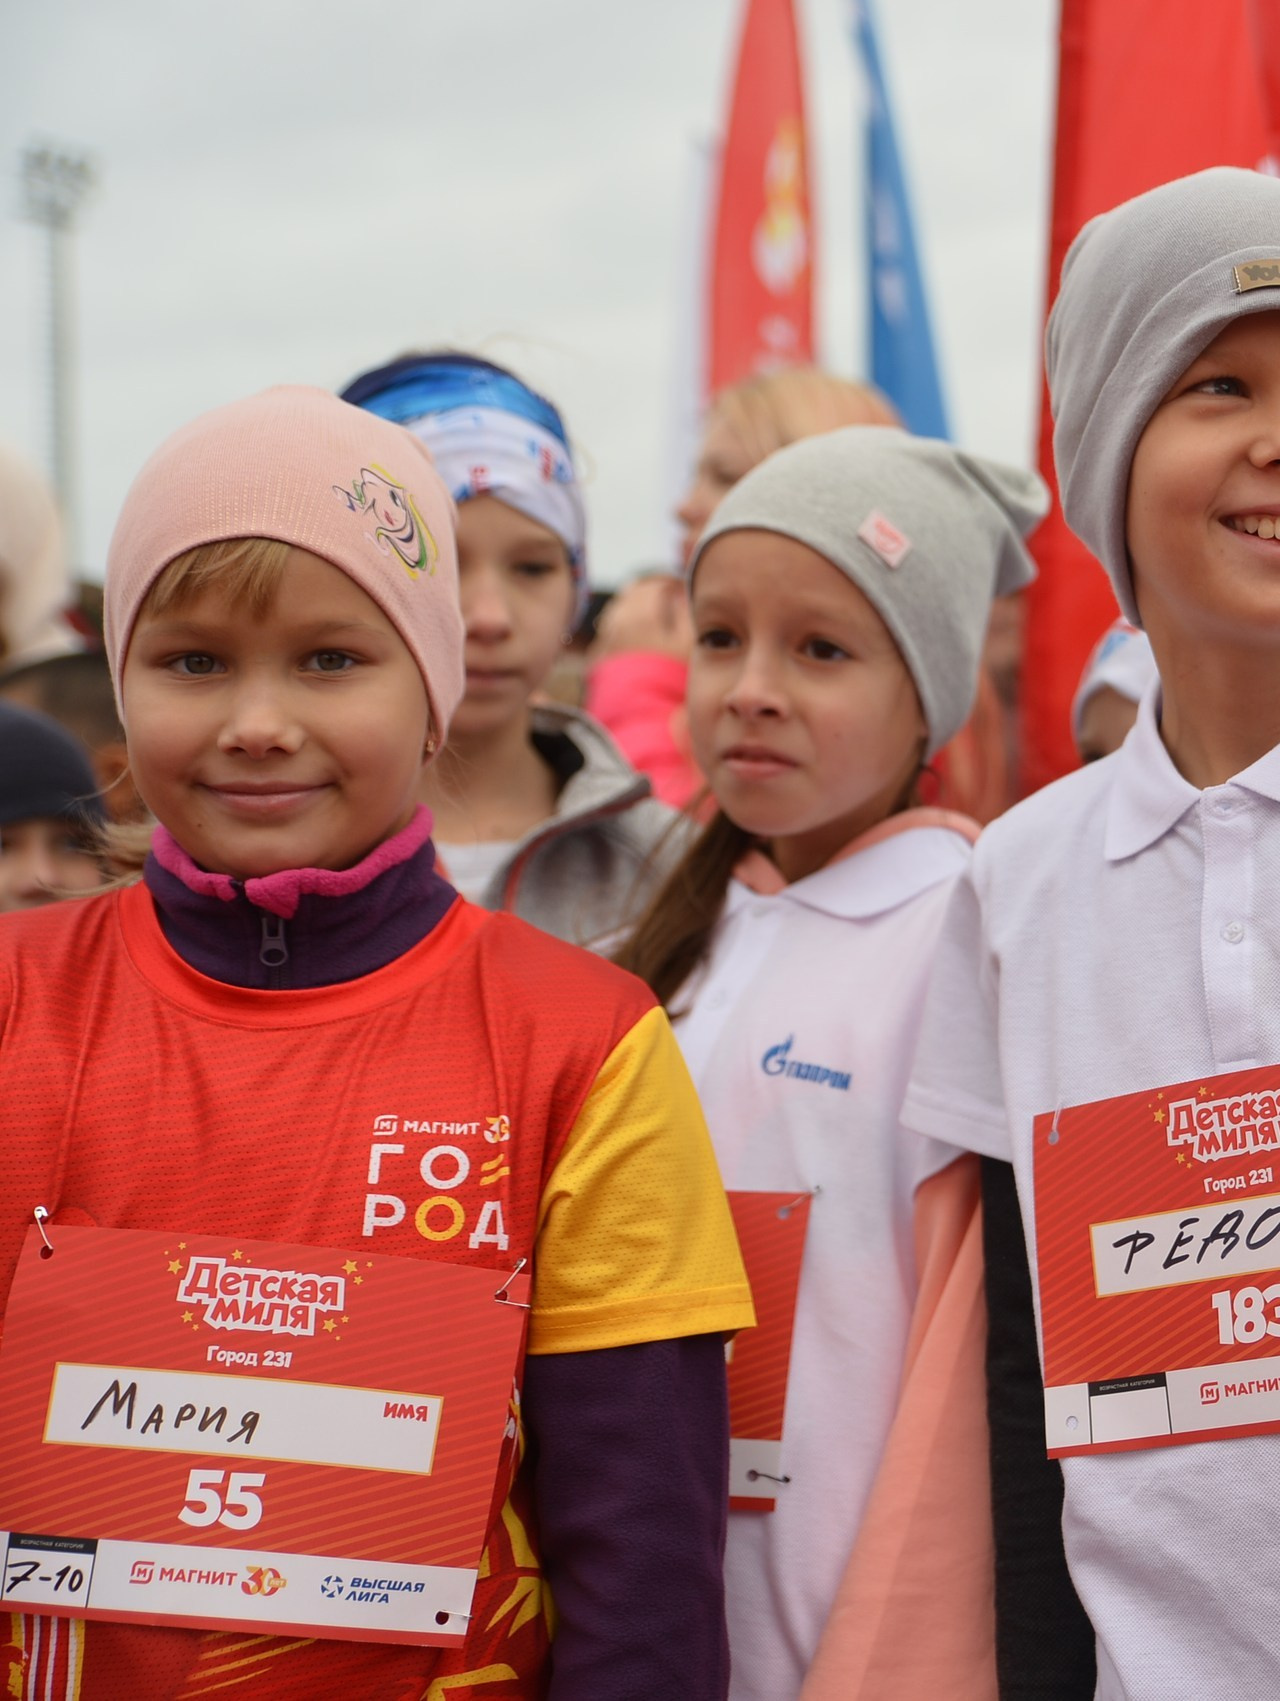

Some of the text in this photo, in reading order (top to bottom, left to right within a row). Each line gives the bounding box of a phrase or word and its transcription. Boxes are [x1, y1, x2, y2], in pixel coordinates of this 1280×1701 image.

[785, 1060, 853, 1091] ГАЗПРОМ
[403, 1120, 480, 1135] МАГНИТ
[1204, 1167, 1273, 1194] Город 231
[183, 1262, 339, 1307] Детская
[206, 1345, 293, 1368] Город 231
[383, 1401, 428, 1422] ИМЯ
[177, 1469, 267, 1531] 55
[6, 1561, 83, 1593] 7-10
[158, 1567, 238, 1586] МАГНИТ
[350, 1577, 425, 1594] ВЫСШАЯ
[345, 1591, 390, 1604] ЛИГА
